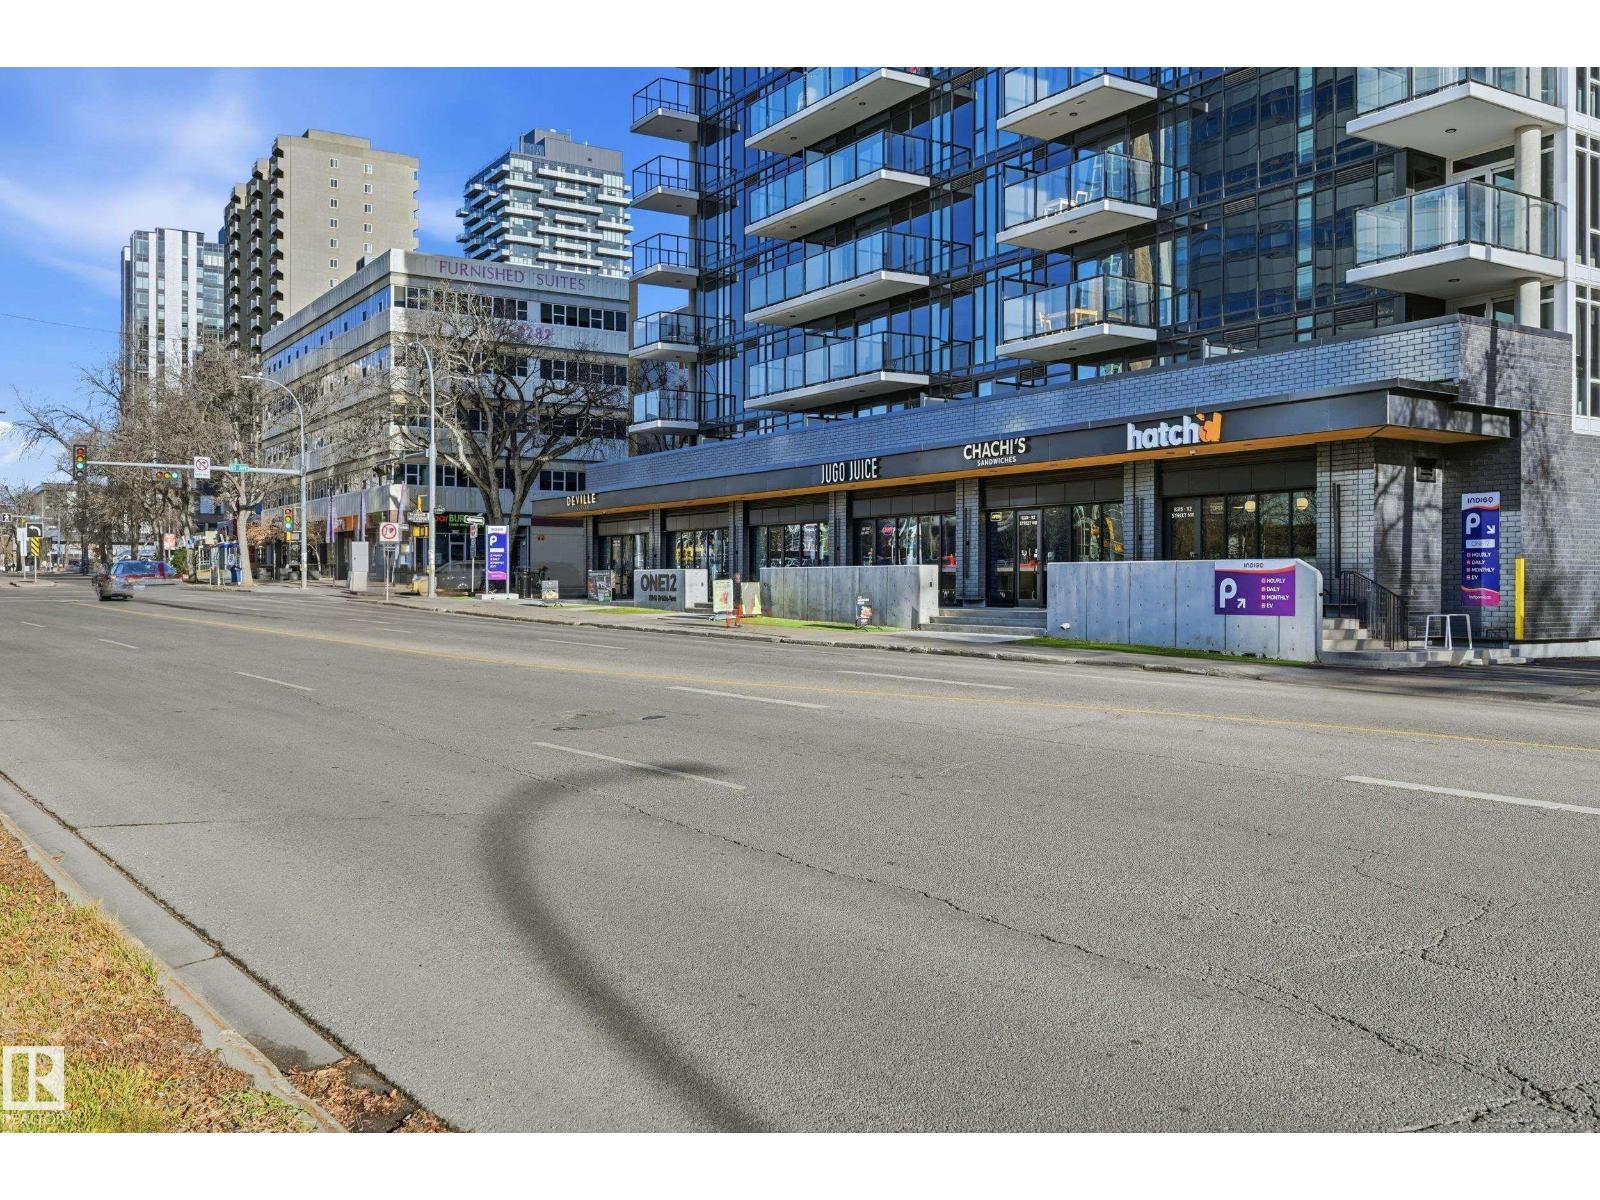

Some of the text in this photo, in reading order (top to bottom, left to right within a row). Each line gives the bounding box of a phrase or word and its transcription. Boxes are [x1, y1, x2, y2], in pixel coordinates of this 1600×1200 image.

[439, 260, 586, 291] FURNISHED SUITES
[963, 437, 1027, 460] CHACHI'S
[821, 457, 878, 484] JUGO JUICE
[976, 455, 1017, 467] SANDWICHES
[566, 493, 596, 507] DEVILLE
[1467, 496, 1494, 504] INDIGO
[1465, 513, 1481, 535] P
[490, 535, 498, 546] P
[1219, 577, 1238, 609] P
